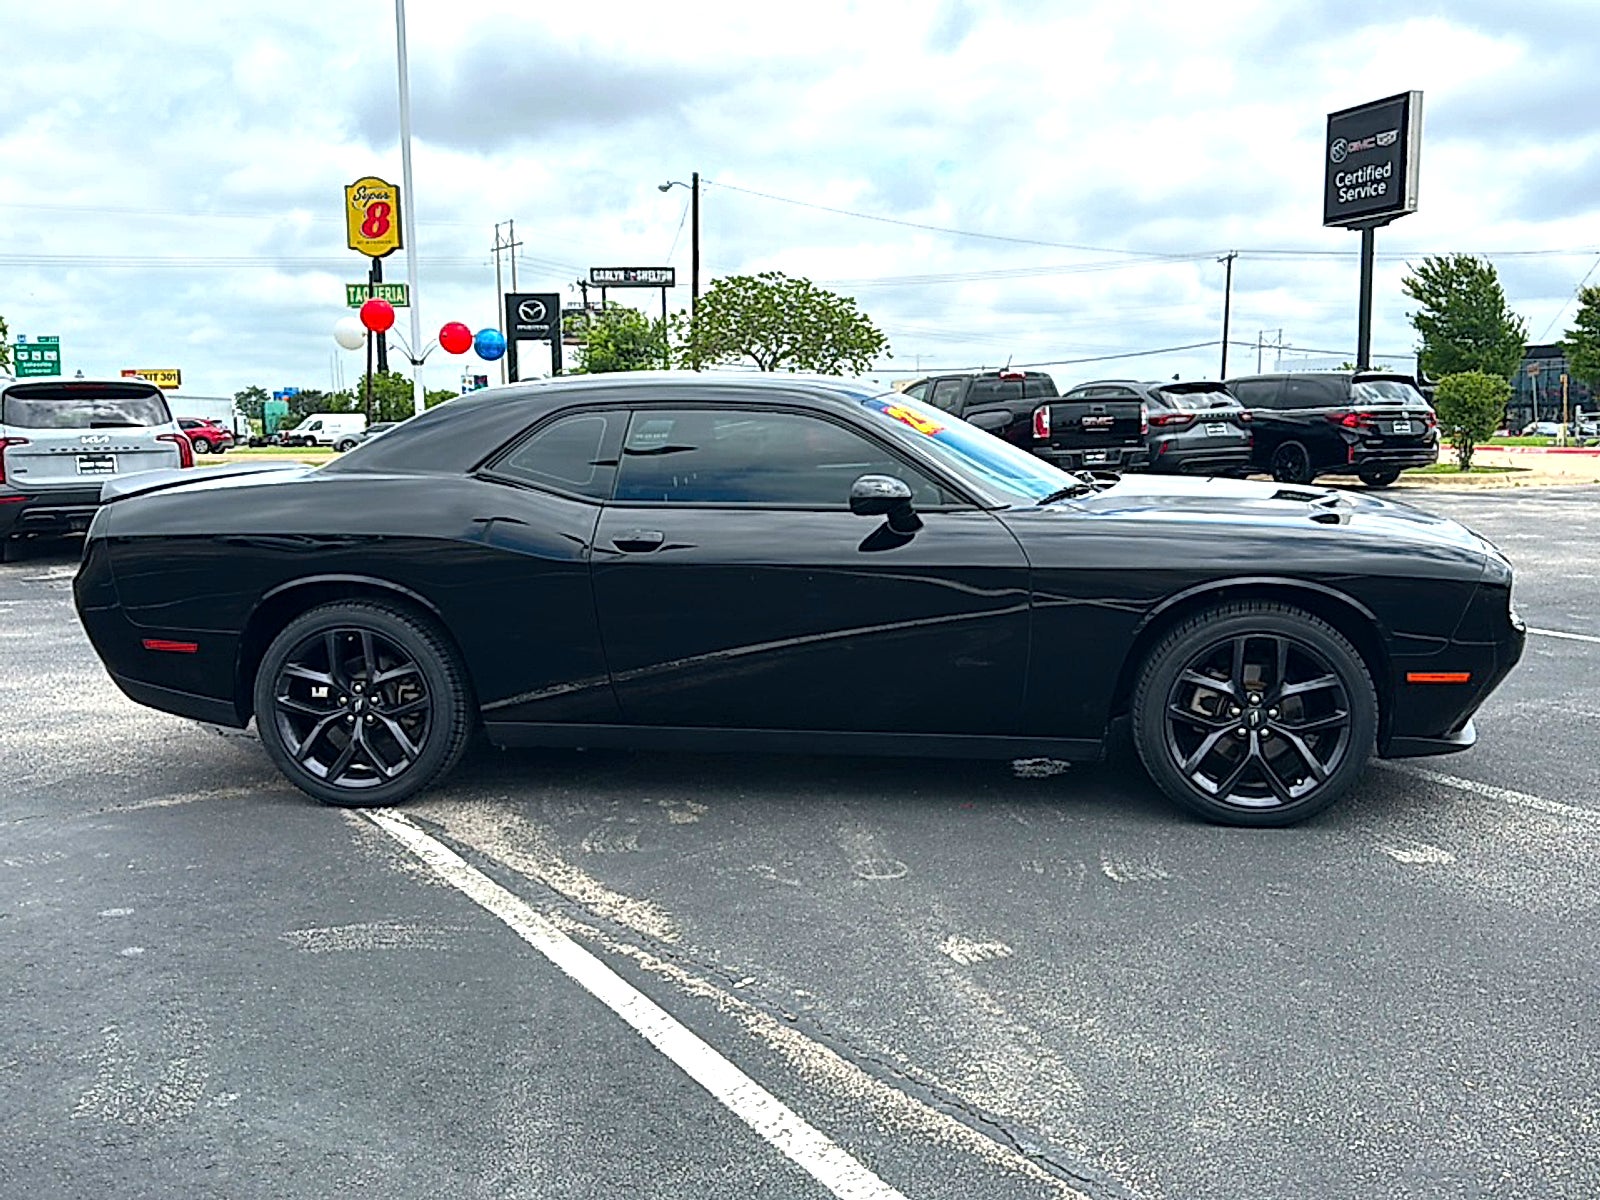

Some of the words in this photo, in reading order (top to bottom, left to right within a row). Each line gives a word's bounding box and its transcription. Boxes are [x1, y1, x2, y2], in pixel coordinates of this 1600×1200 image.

[1335, 161, 1392, 187] Certified
[352, 186, 390, 207] Super
[1338, 182, 1387, 203] Service
[361, 202, 391, 239] 8
[160, 373, 176, 381] 301
[1081, 416, 1115, 426] GMC
